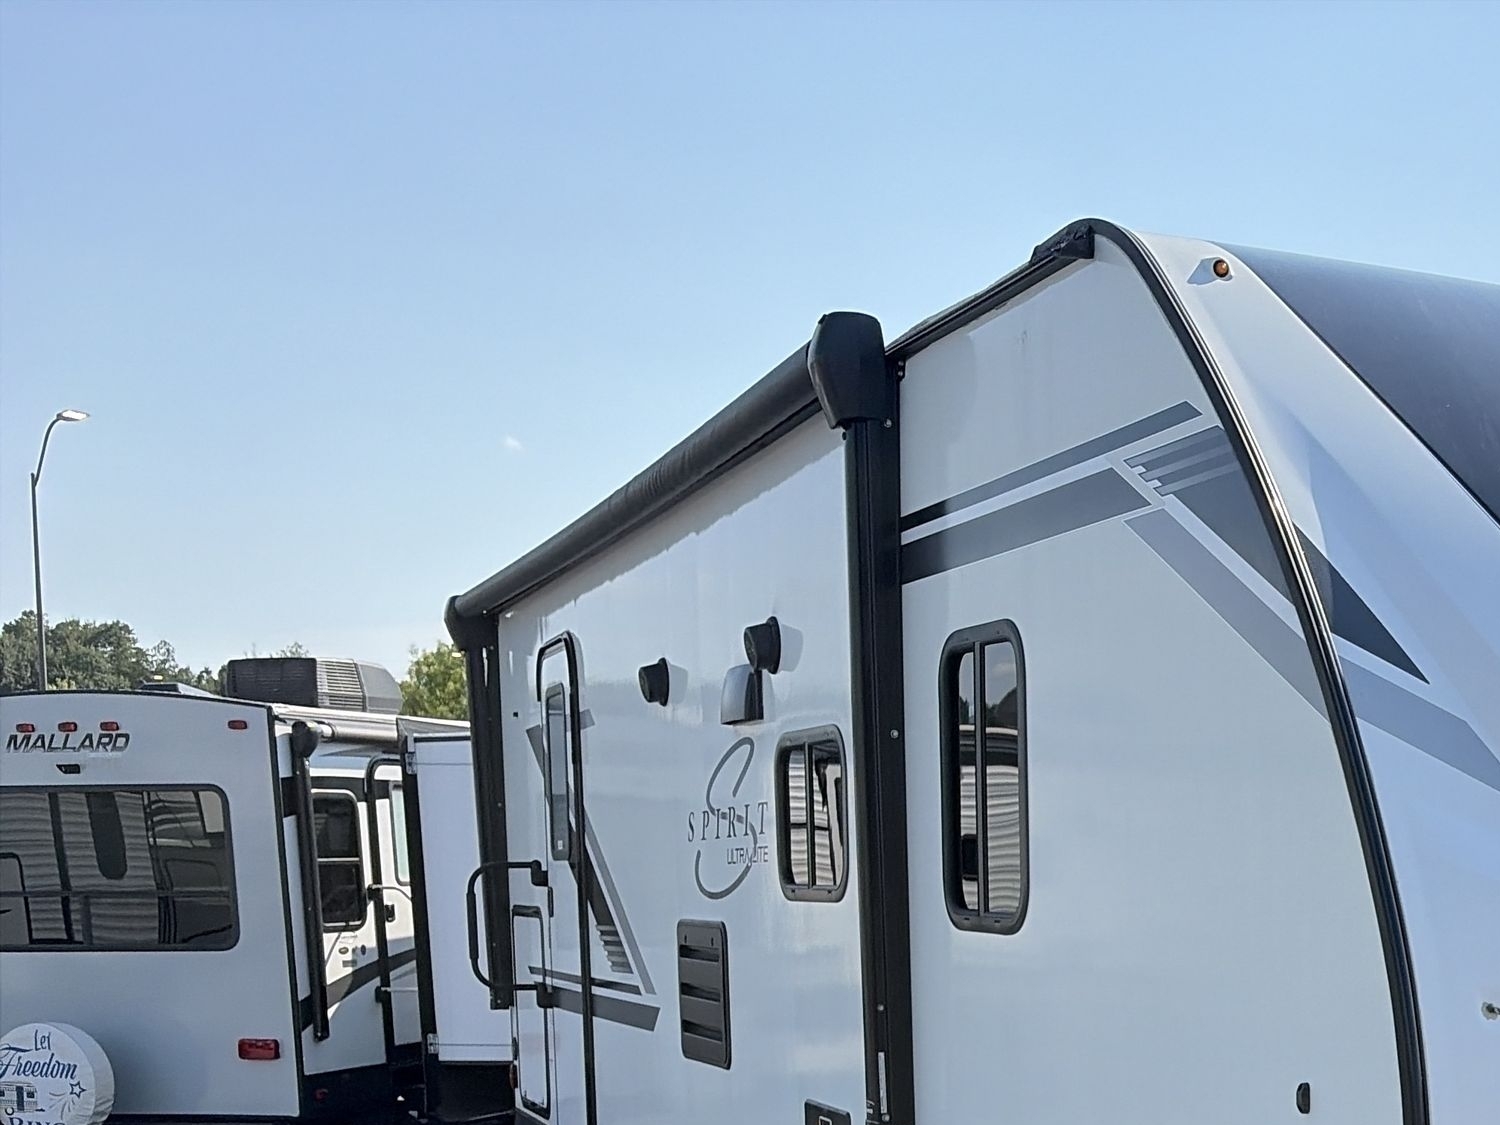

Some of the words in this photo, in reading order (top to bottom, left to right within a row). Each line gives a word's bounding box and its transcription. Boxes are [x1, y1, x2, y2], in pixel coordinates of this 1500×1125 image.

[6, 733, 130, 753] MALLARD
[687, 801, 769, 843] SPIRIT
[0, 1042, 78, 1081] Freedom
